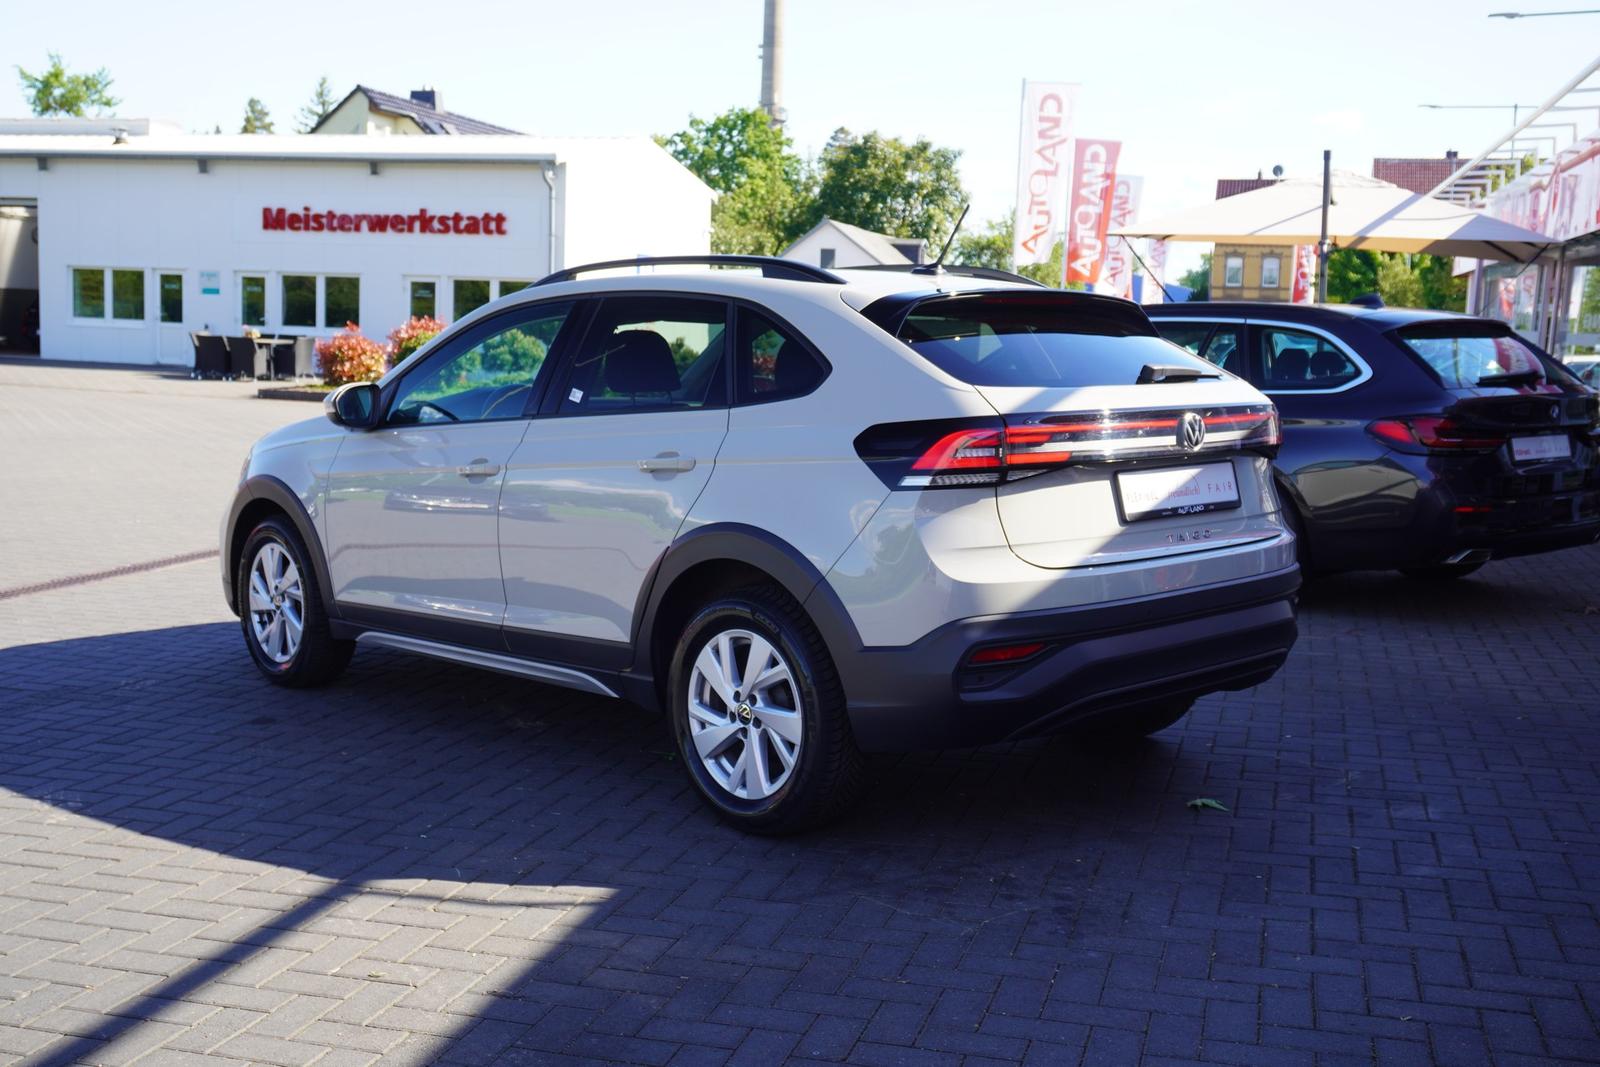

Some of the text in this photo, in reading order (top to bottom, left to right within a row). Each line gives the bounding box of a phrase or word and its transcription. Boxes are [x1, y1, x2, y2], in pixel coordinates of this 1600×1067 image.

[262, 206, 507, 235] Meisterwerkstatt
[1021, 92, 1068, 255] AUTOLAND
[1070, 143, 1113, 276] AUTOLAND
[1103, 180, 1134, 286] AUTOAND
